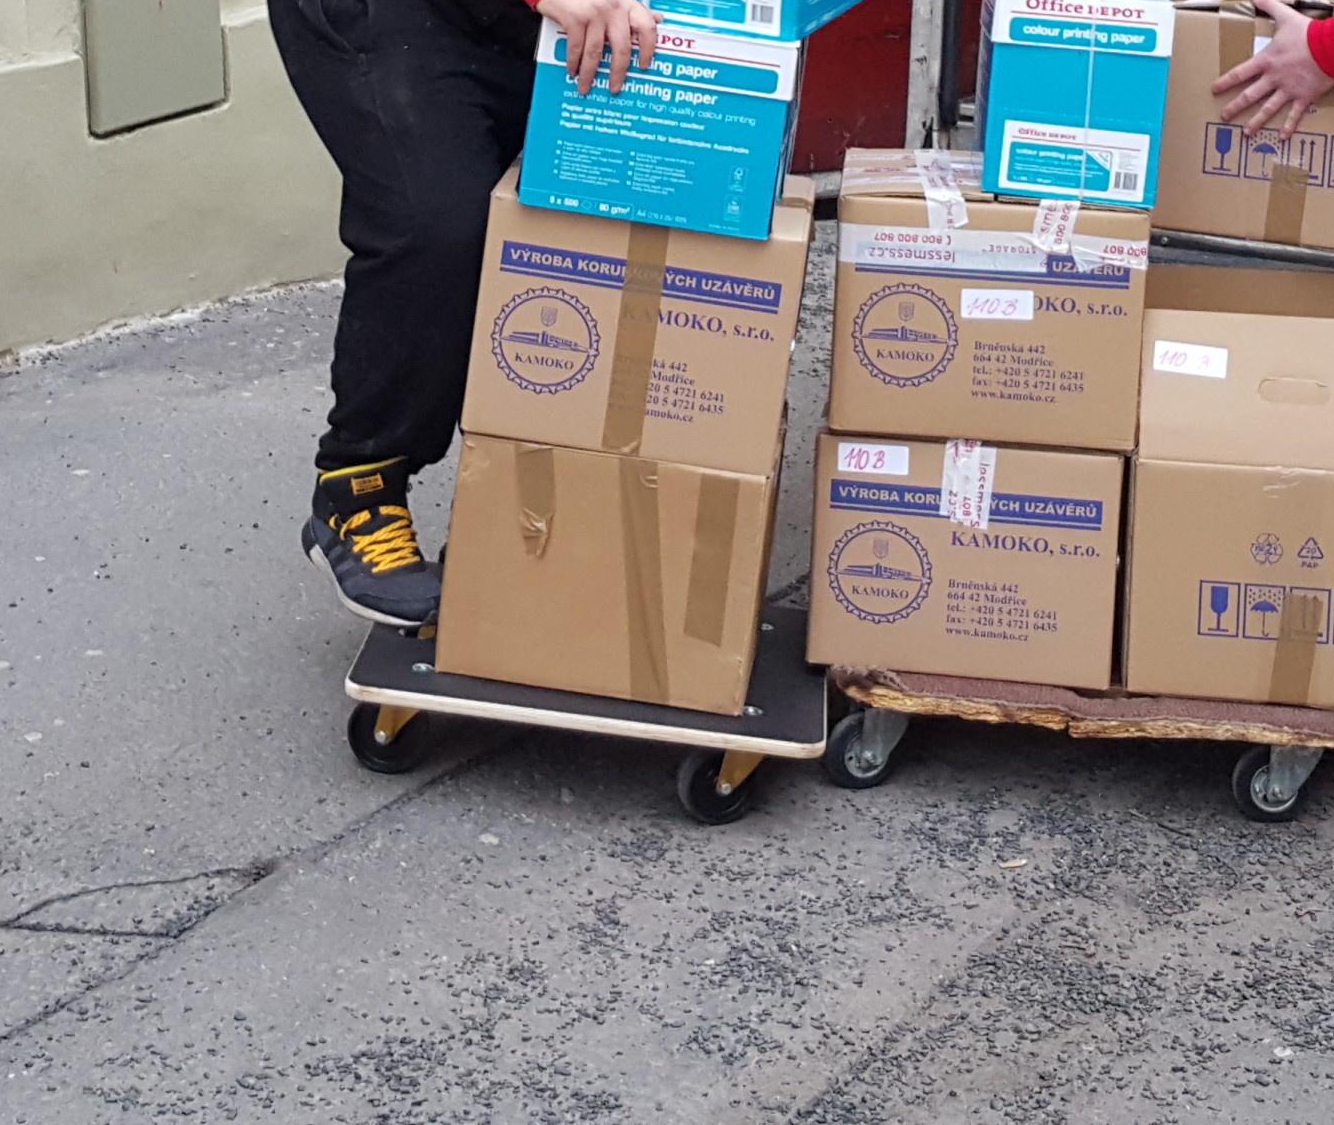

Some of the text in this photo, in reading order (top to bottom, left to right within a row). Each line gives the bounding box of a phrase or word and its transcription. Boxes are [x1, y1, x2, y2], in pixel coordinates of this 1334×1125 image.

[1023, 24, 1060, 37] colour
[1111, 32, 1146, 45] paper
[676, 61, 718, 80] paper
[676, 89, 718, 106] paper
[874, 232, 895, 243] 807
[897, 233, 918, 243] 800
[869, 246, 956, 263] lessmess.cz
[510, 247, 573, 269] VÝROBA
[701, 277, 776, 301] UZÁVĚRŮ
[1086, 302, 1128, 317] s.r.o.
[733, 324, 775, 342] s.r.o.
[876, 348, 935, 363] KAMOKO
[1027, 345, 1046, 355] 442
[514, 352, 574, 371] KAMOKO
[668, 361, 688, 373] 442
[995, 354, 1007, 364] 42
[1011, 355, 1055, 368] Modřice
[1023, 368, 1030, 378] 5
[1033, 369, 1056, 380] 4721
[1060, 371, 1085, 381] 6241
[663, 385, 670, 395] 5
[673, 387, 697, 399] 4721
[700, 391, 725, 403] 6241
[1023, 379, 1030, 390] 5
[1032, 380, 1056, 392] 4721
[1059, 382, 1085, 393] 6435
[671, 398, 695, 411] 4721
[698, 403, 725, 416] 6435
[843, 447, 886, 470] 110 B
[838, 484, 900, 503] VÝROBA
[951, 530, 1101, 558] KAMOKO, s.r.o.
[851, 584, 910, 600] KAMOKO
[948, 578, 1019, 594] Brněnská 442
[947, 591, 1027, 606] 664 42 Modřice
[997, 606, 1004, 616] 5
[1006, 607, 1030, 619] 4721
[1033, 609, 1057, 621] 6241
[997, 618, 1004, 628] 5
[1006, 619, 1029, 630] 4721
[1033, 622, 1058, 633] 6435
